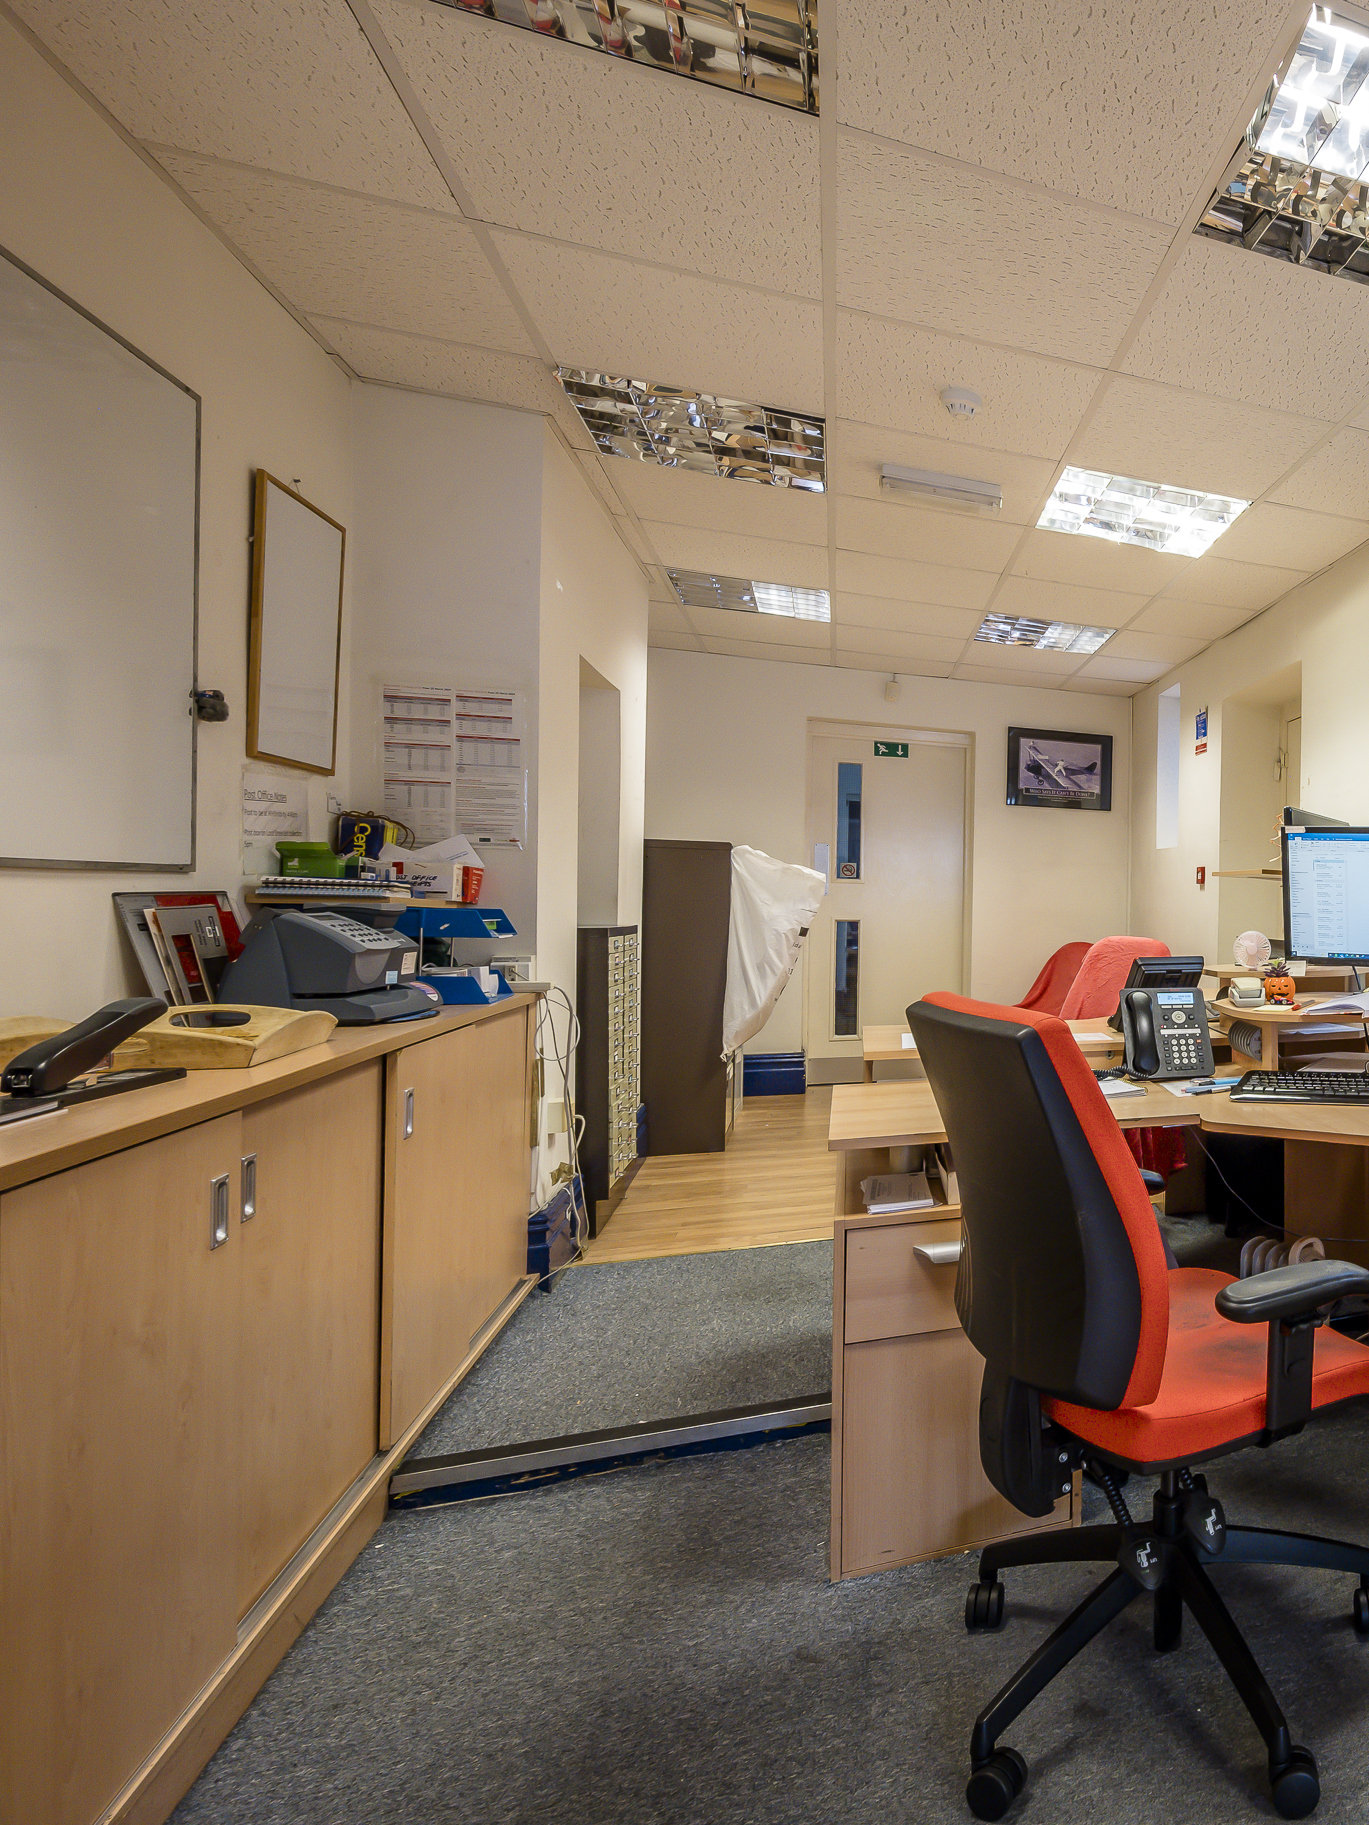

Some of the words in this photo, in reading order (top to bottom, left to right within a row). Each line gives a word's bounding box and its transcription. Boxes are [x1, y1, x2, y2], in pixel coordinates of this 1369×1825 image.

[244, 789, 256, 799] Post
[257, 790, 273, 801] Office
[274, 792, 287, 802] Notes
[411, 874, 438, 882] OFFICE
